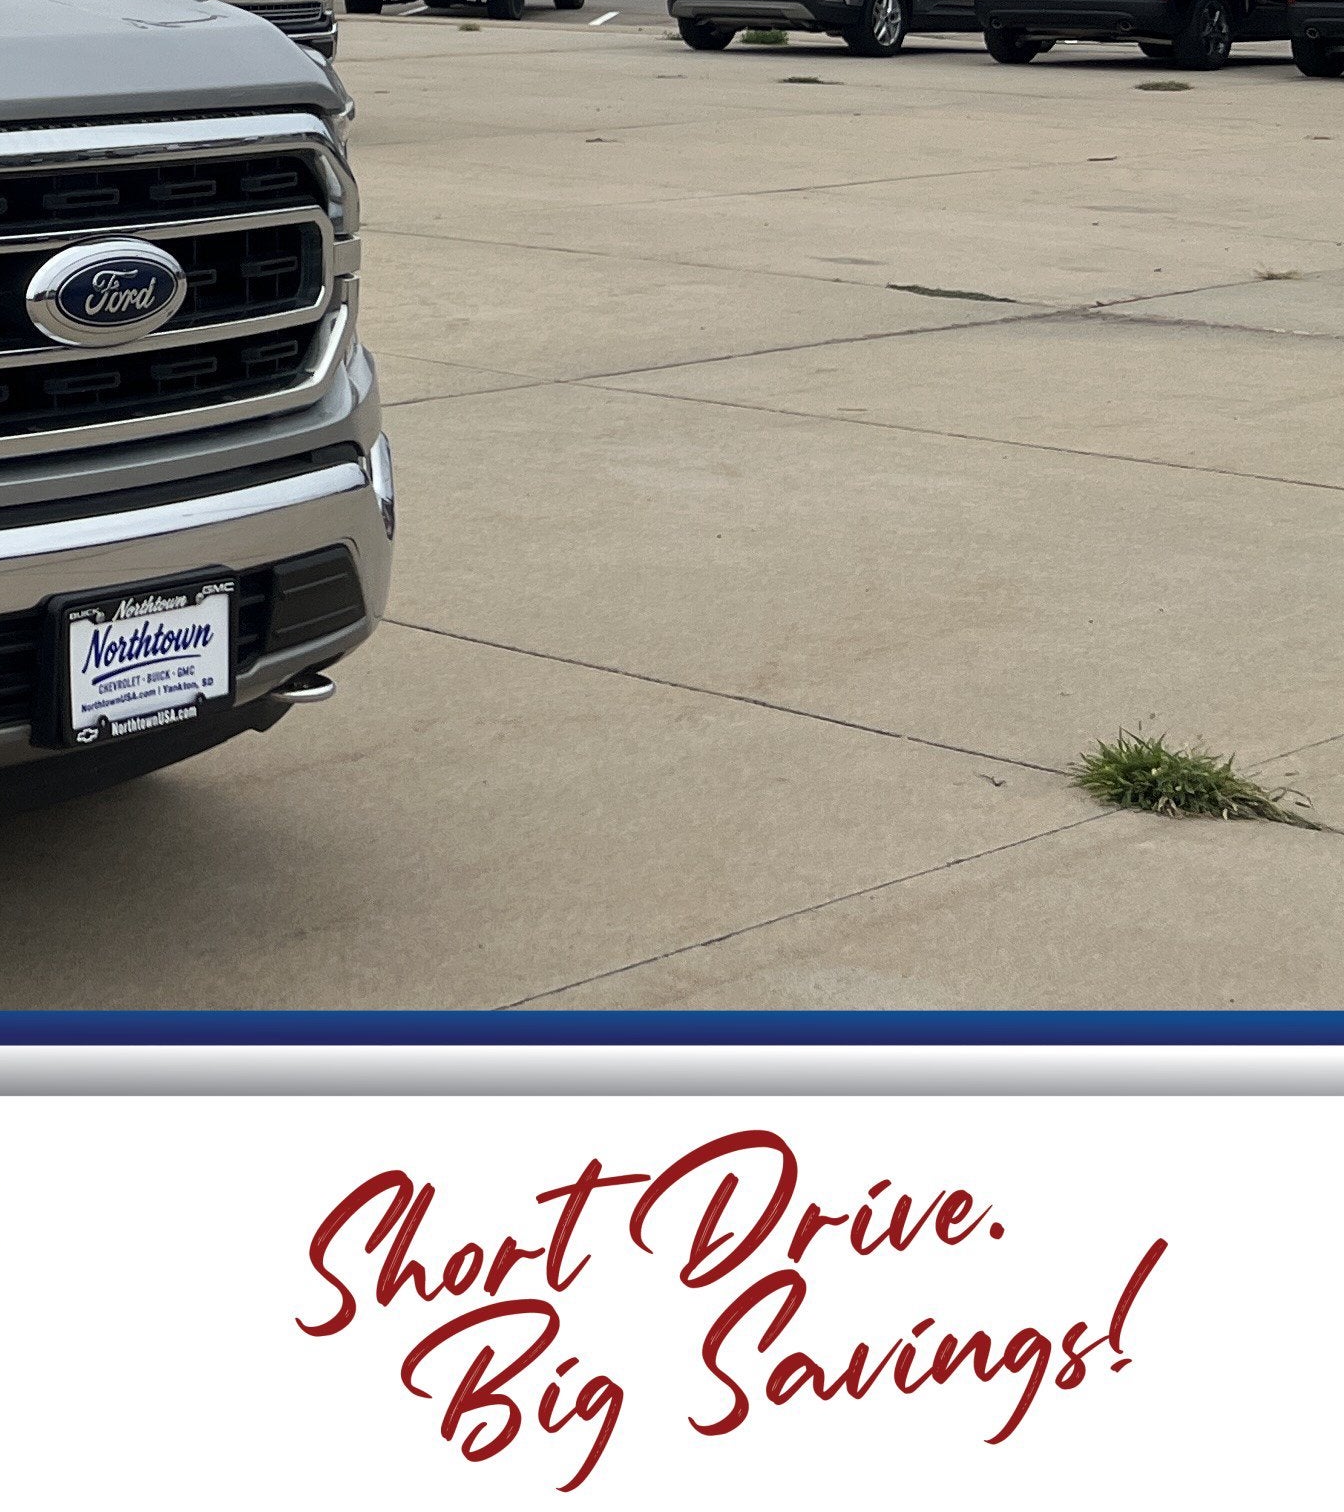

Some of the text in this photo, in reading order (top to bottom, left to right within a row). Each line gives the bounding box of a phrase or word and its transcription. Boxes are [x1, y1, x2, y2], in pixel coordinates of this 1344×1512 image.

[85, 269, 156, 316] Ford
[112, 594, 188, 623] Northtown
[202, 581, 235, 594] GMC
[81, 620, 214, 674] Northtown
[98, 665, 196, 694] CHEVROLET BUICK GMC
[81, 688, 156, 713] NorthtownUSA.com
[112, 706, 197, 736] NorthtownUSA.com
